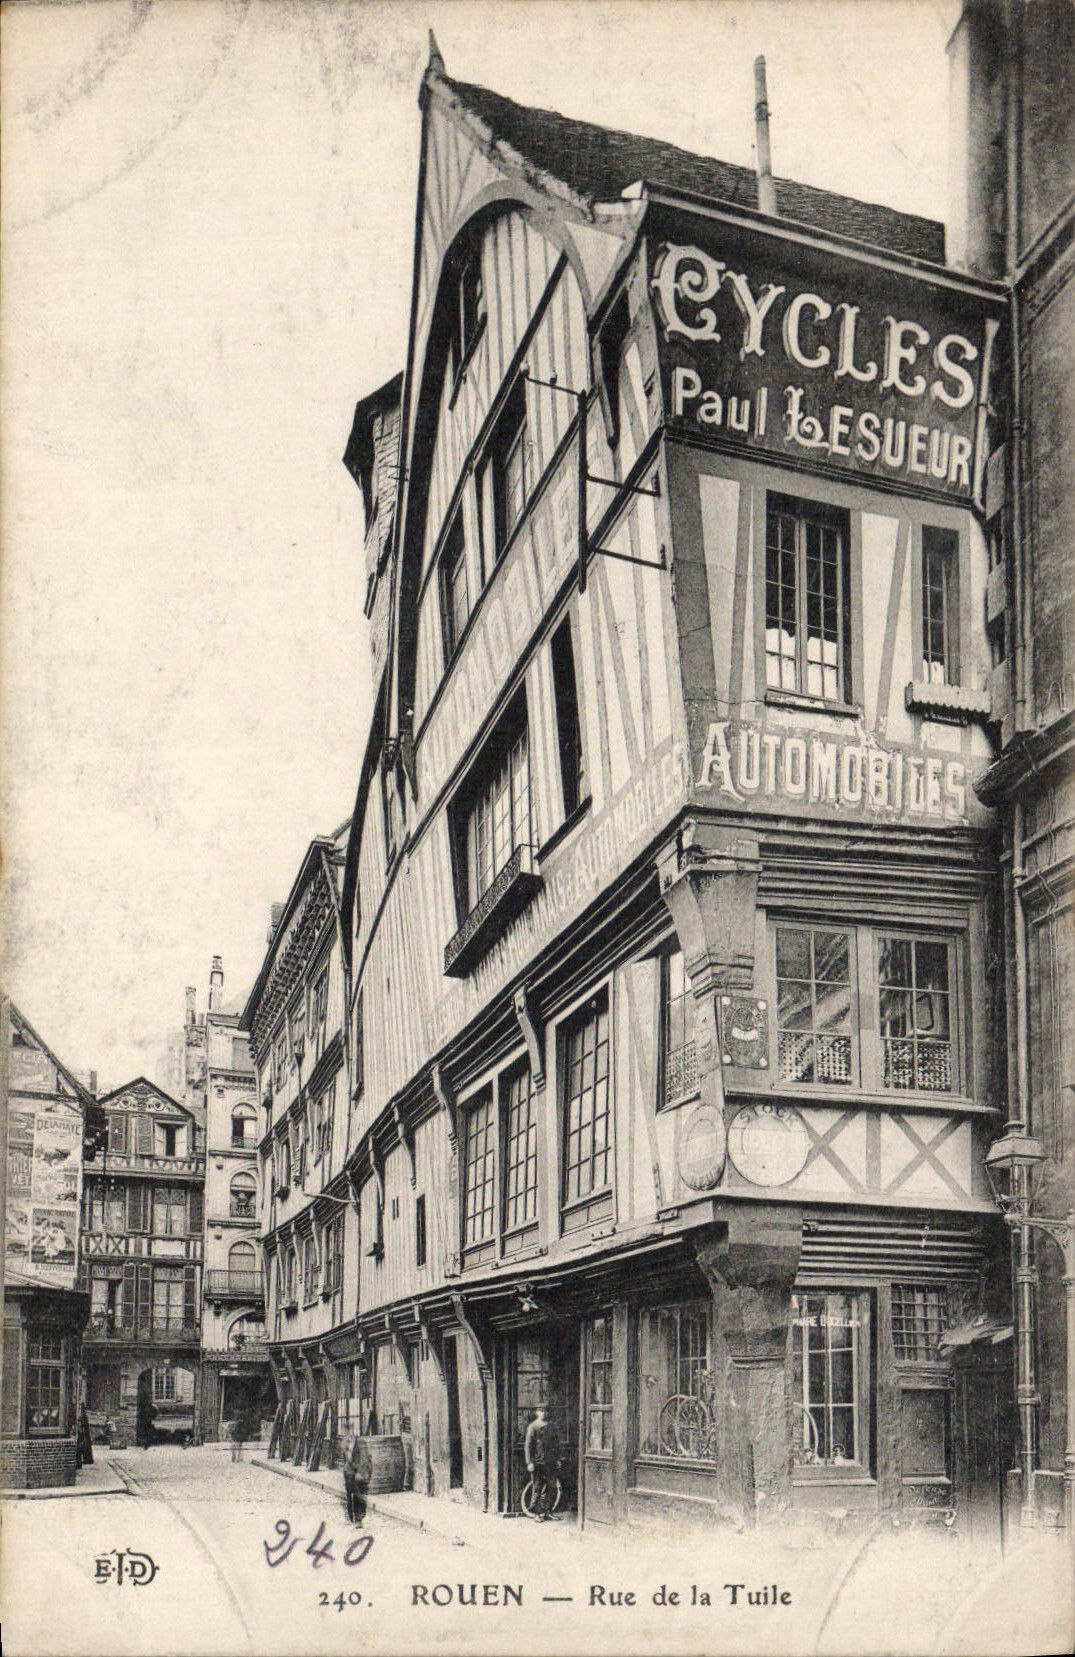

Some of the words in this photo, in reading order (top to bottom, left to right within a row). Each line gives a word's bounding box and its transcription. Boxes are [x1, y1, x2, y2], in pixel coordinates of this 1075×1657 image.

[651, 241, 979, 409] CYCLES
[671, 366, 768, 438] Paul
[783, 385, 973, 487] LESUEUR
[695, 721, 967, 815] AUTOMOBILES
[263, 1519, 375, 1568] 240
